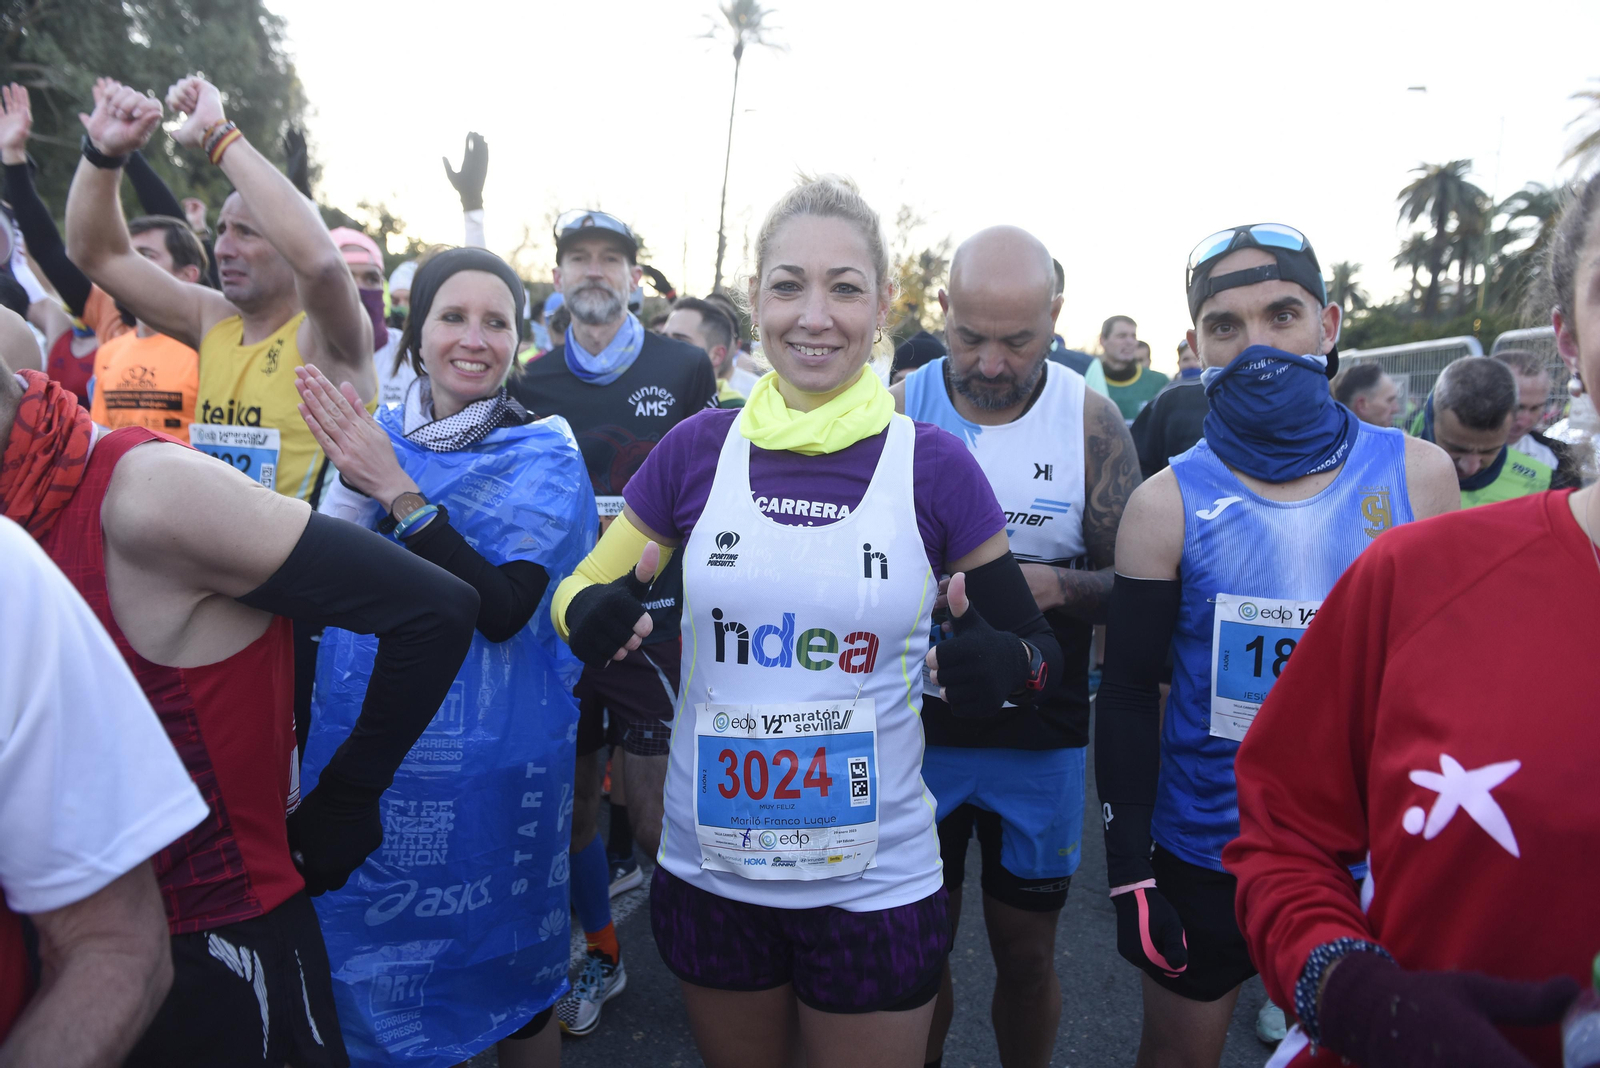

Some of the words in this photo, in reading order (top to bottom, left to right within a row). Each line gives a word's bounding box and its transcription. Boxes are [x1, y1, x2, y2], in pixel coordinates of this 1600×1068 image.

[627, 385, 677, 407] runners
[202, 399, 262, 427] teika
[635, 401, 668, 417] AMS
[754, 495, 852, 519] CARRERA
[863, 542, 889, 580] in
[1261, 605, 1293, 624] edp
[711, 607, 880, 674] indea
[1243, 691, 1269, 702] JESÚ
[731, 713, 757, 735] edp
[780, 708, 840, 723] maratón
[795, 718, 842, 733] sevilla
[413, 738, 464, 749] ORRIERE
[404, 750, 464, 761] SPRESSO
[717, 746, 833, 801] 3024
[511, 762, 547, 897] START
[730, 815, 761, 827] Mariló
[764, 816, 801, 826] Franco
[803, 815, 837, 827] Luque
[779, 829, 810, 848] edp
[382, 850, 448, 866] THON
[743, 857, 767, 866] HOKA
[414, 875, 493, 918] asics
[374, 1009, 422, 1032] CORRIERE
[374, 1020, 423, 1044] ESPRESSO
